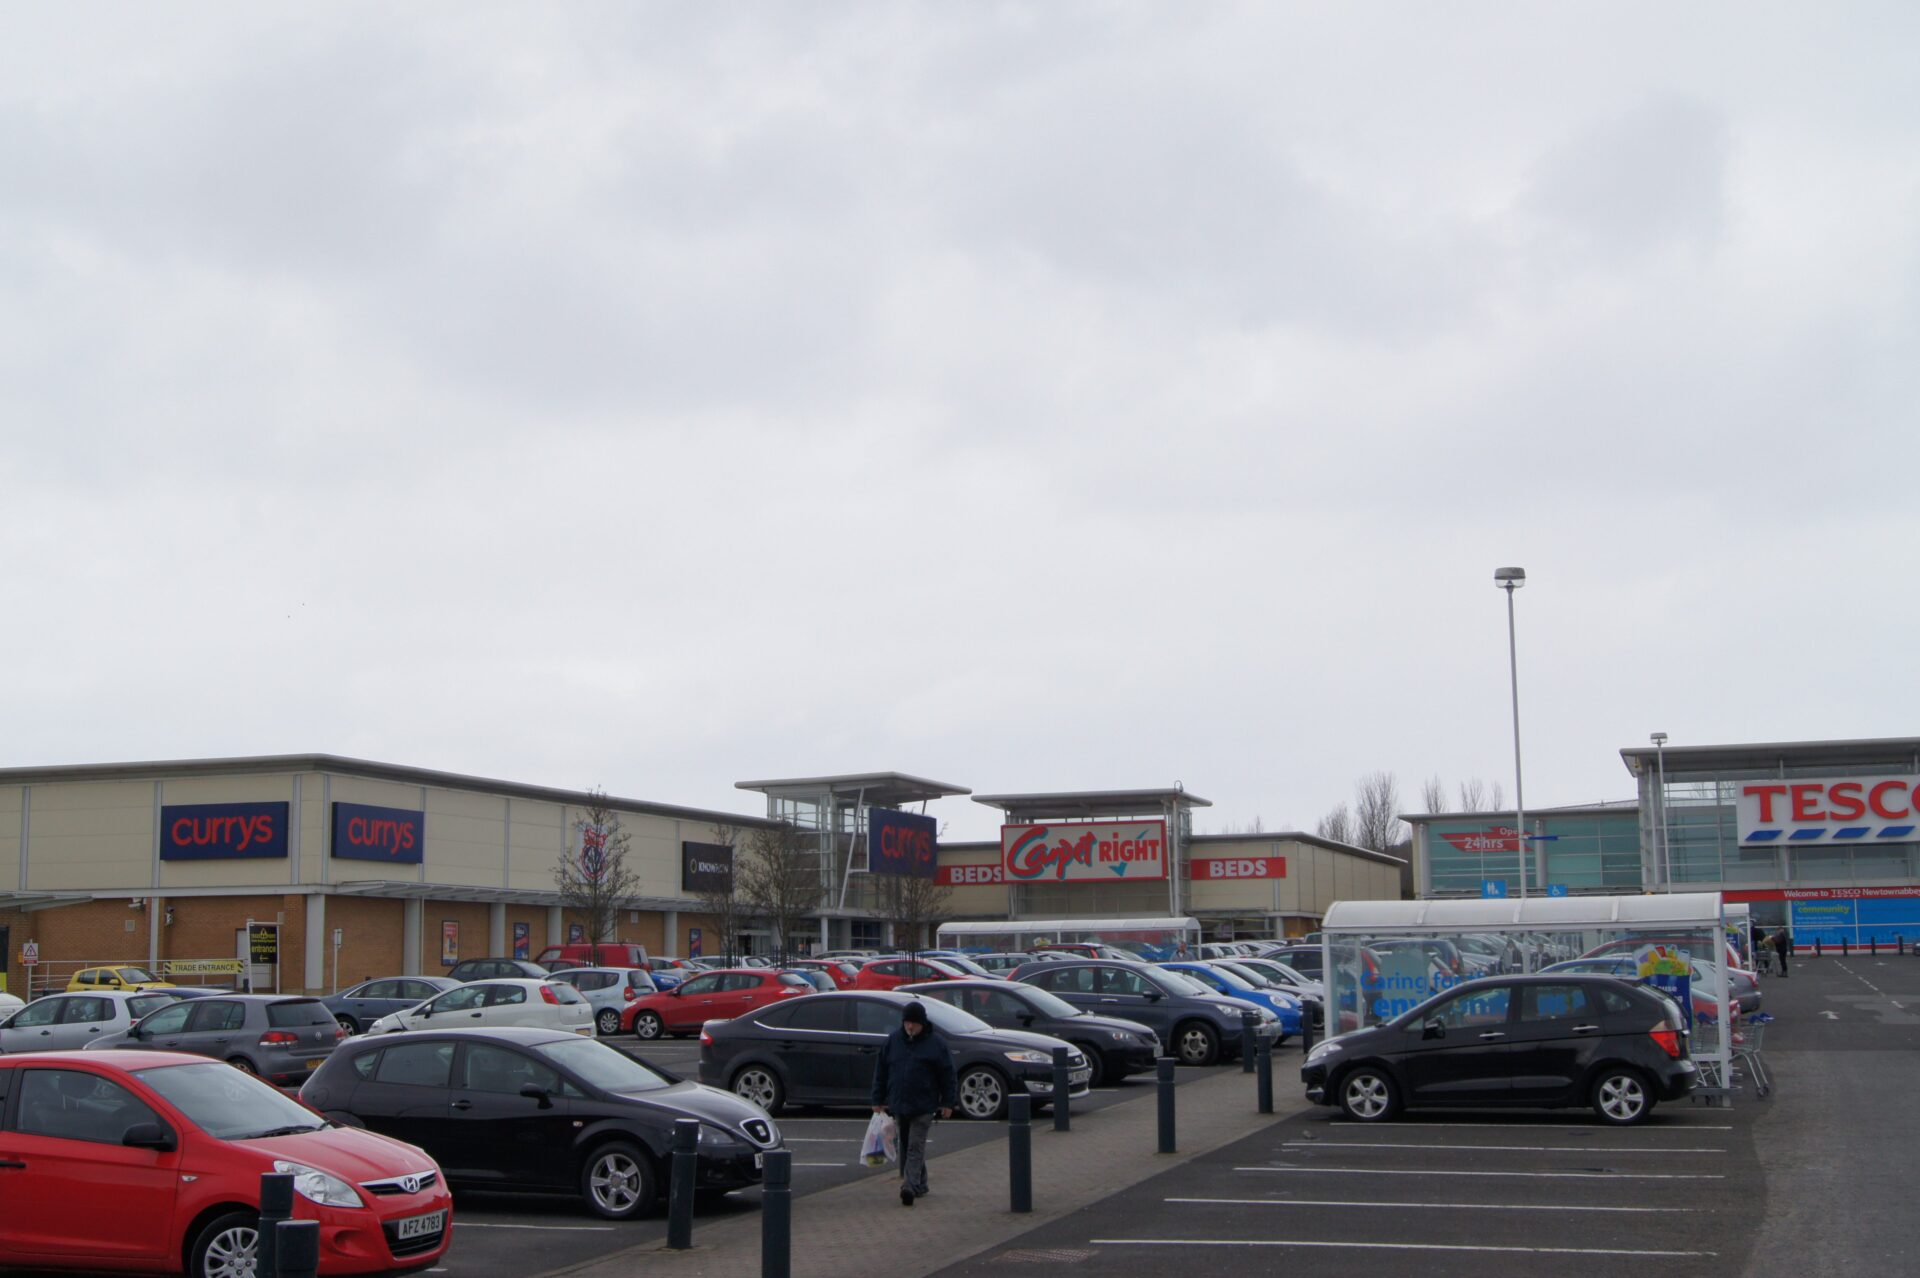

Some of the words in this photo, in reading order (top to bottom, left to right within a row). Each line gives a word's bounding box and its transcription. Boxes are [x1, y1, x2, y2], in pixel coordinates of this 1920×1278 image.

[1743, 780, 1920, 823] TESC
[171, 815, 273, 851] currys
[348, 817, 414, 854] currys
[1007, 826, 1097, 881] Carpet
[950, 867, 1001, 884] BEDS
[1209, 860, 1268, 878] BEDS
[1784, 890, 1819, 898] Welcome
[1798, 904, 1850, 914] community
[175, 964, 197, 972] TRADE
[198, 963, 235, 972] ENTRANCE
[1360, 971, 1425, 993] Caring
[403, 1219, 419, 1235] AFZ
[421, 1215, 440, 1232] 4783
